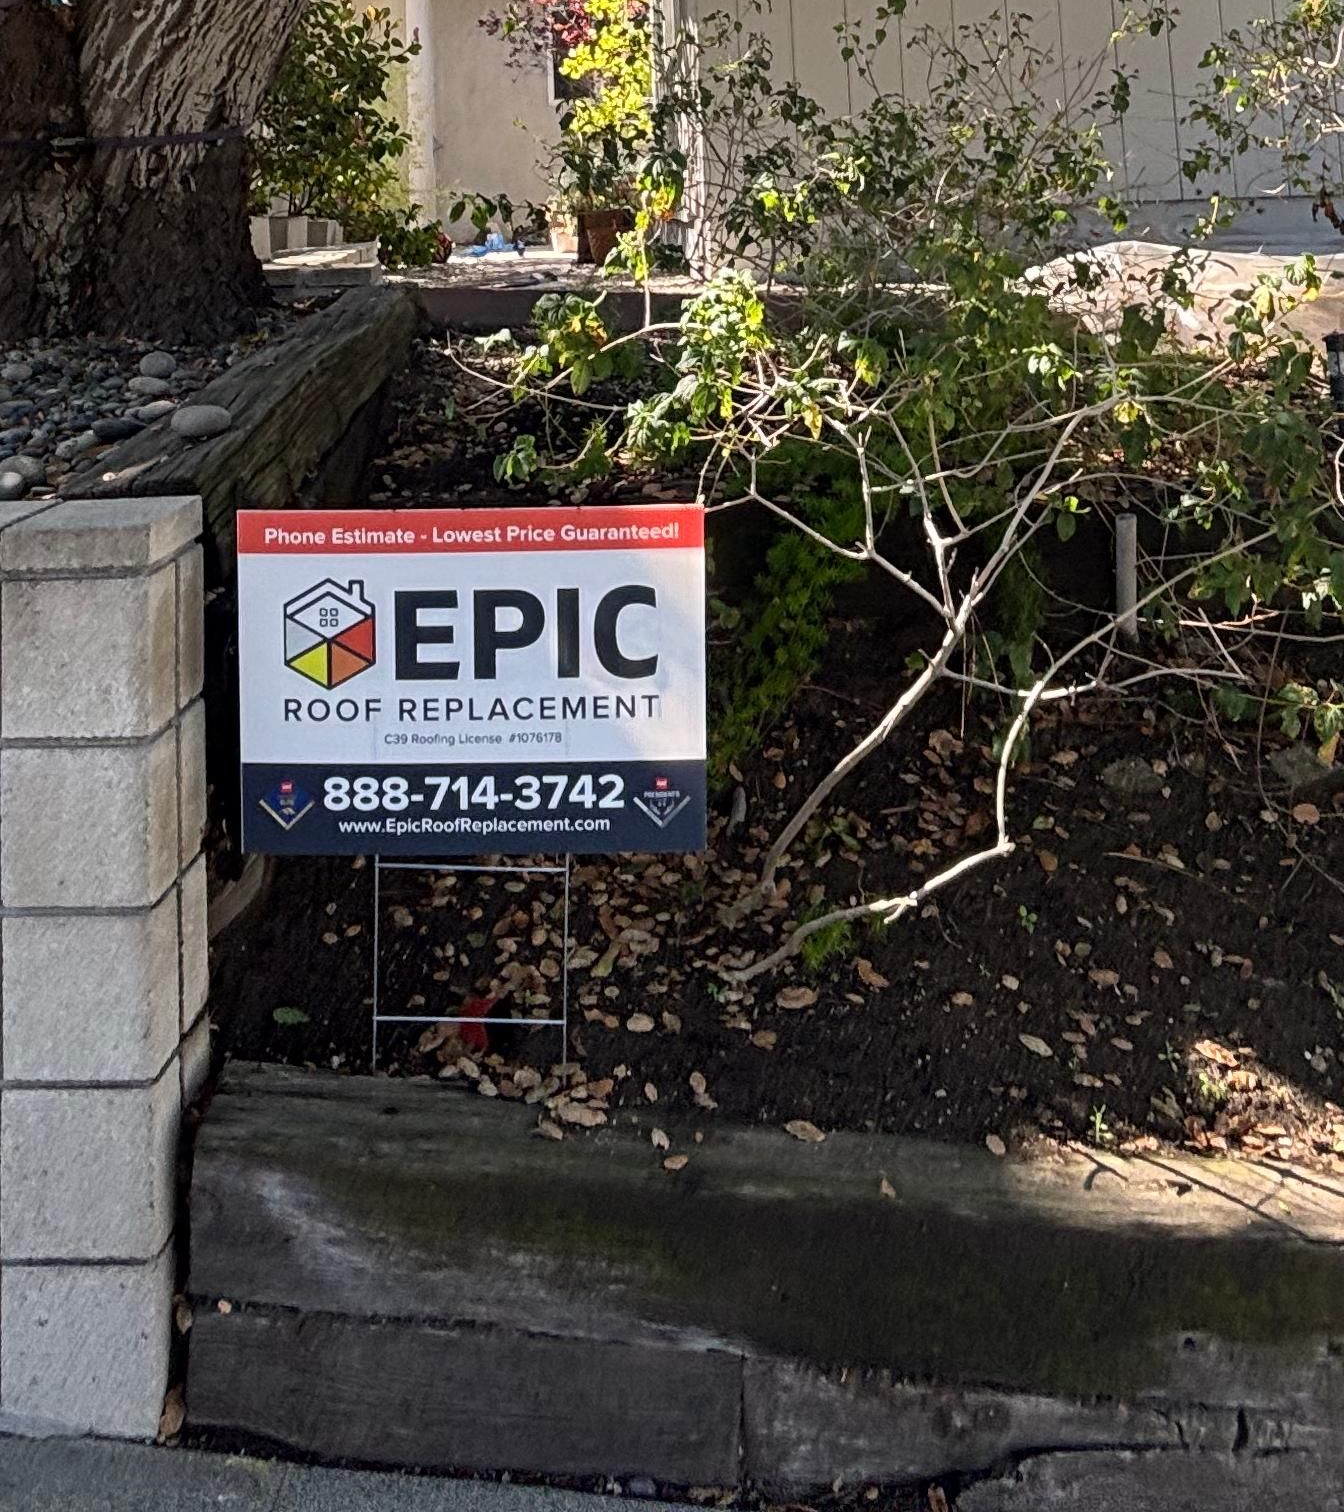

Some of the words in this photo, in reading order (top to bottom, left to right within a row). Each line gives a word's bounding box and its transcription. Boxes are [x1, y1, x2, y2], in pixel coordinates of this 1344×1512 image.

[264, 527, 326, 545] Phone
[331, 527, 416, 545] Estimate
[432, 526, 502, 544] Lowest
[506, 525, 556, 543] Price
[560, 522, 680, 541] Guaranteed!
[394, 584, 659, 681] EPIC
[284, 698, 383, 723] ROOF
[398, 694, 660, 722] REPLACEMENT
[384, 733, 408, 745] C39
[411, 733, 456, 747] Roofing
[458, 733, 503, 745] License
[508, 731, 563, 744] #1076178
[322, 773, 625, 812] 888-714-3742
[338, 816, 611, 836] www.EpicRoofReplacement.com
